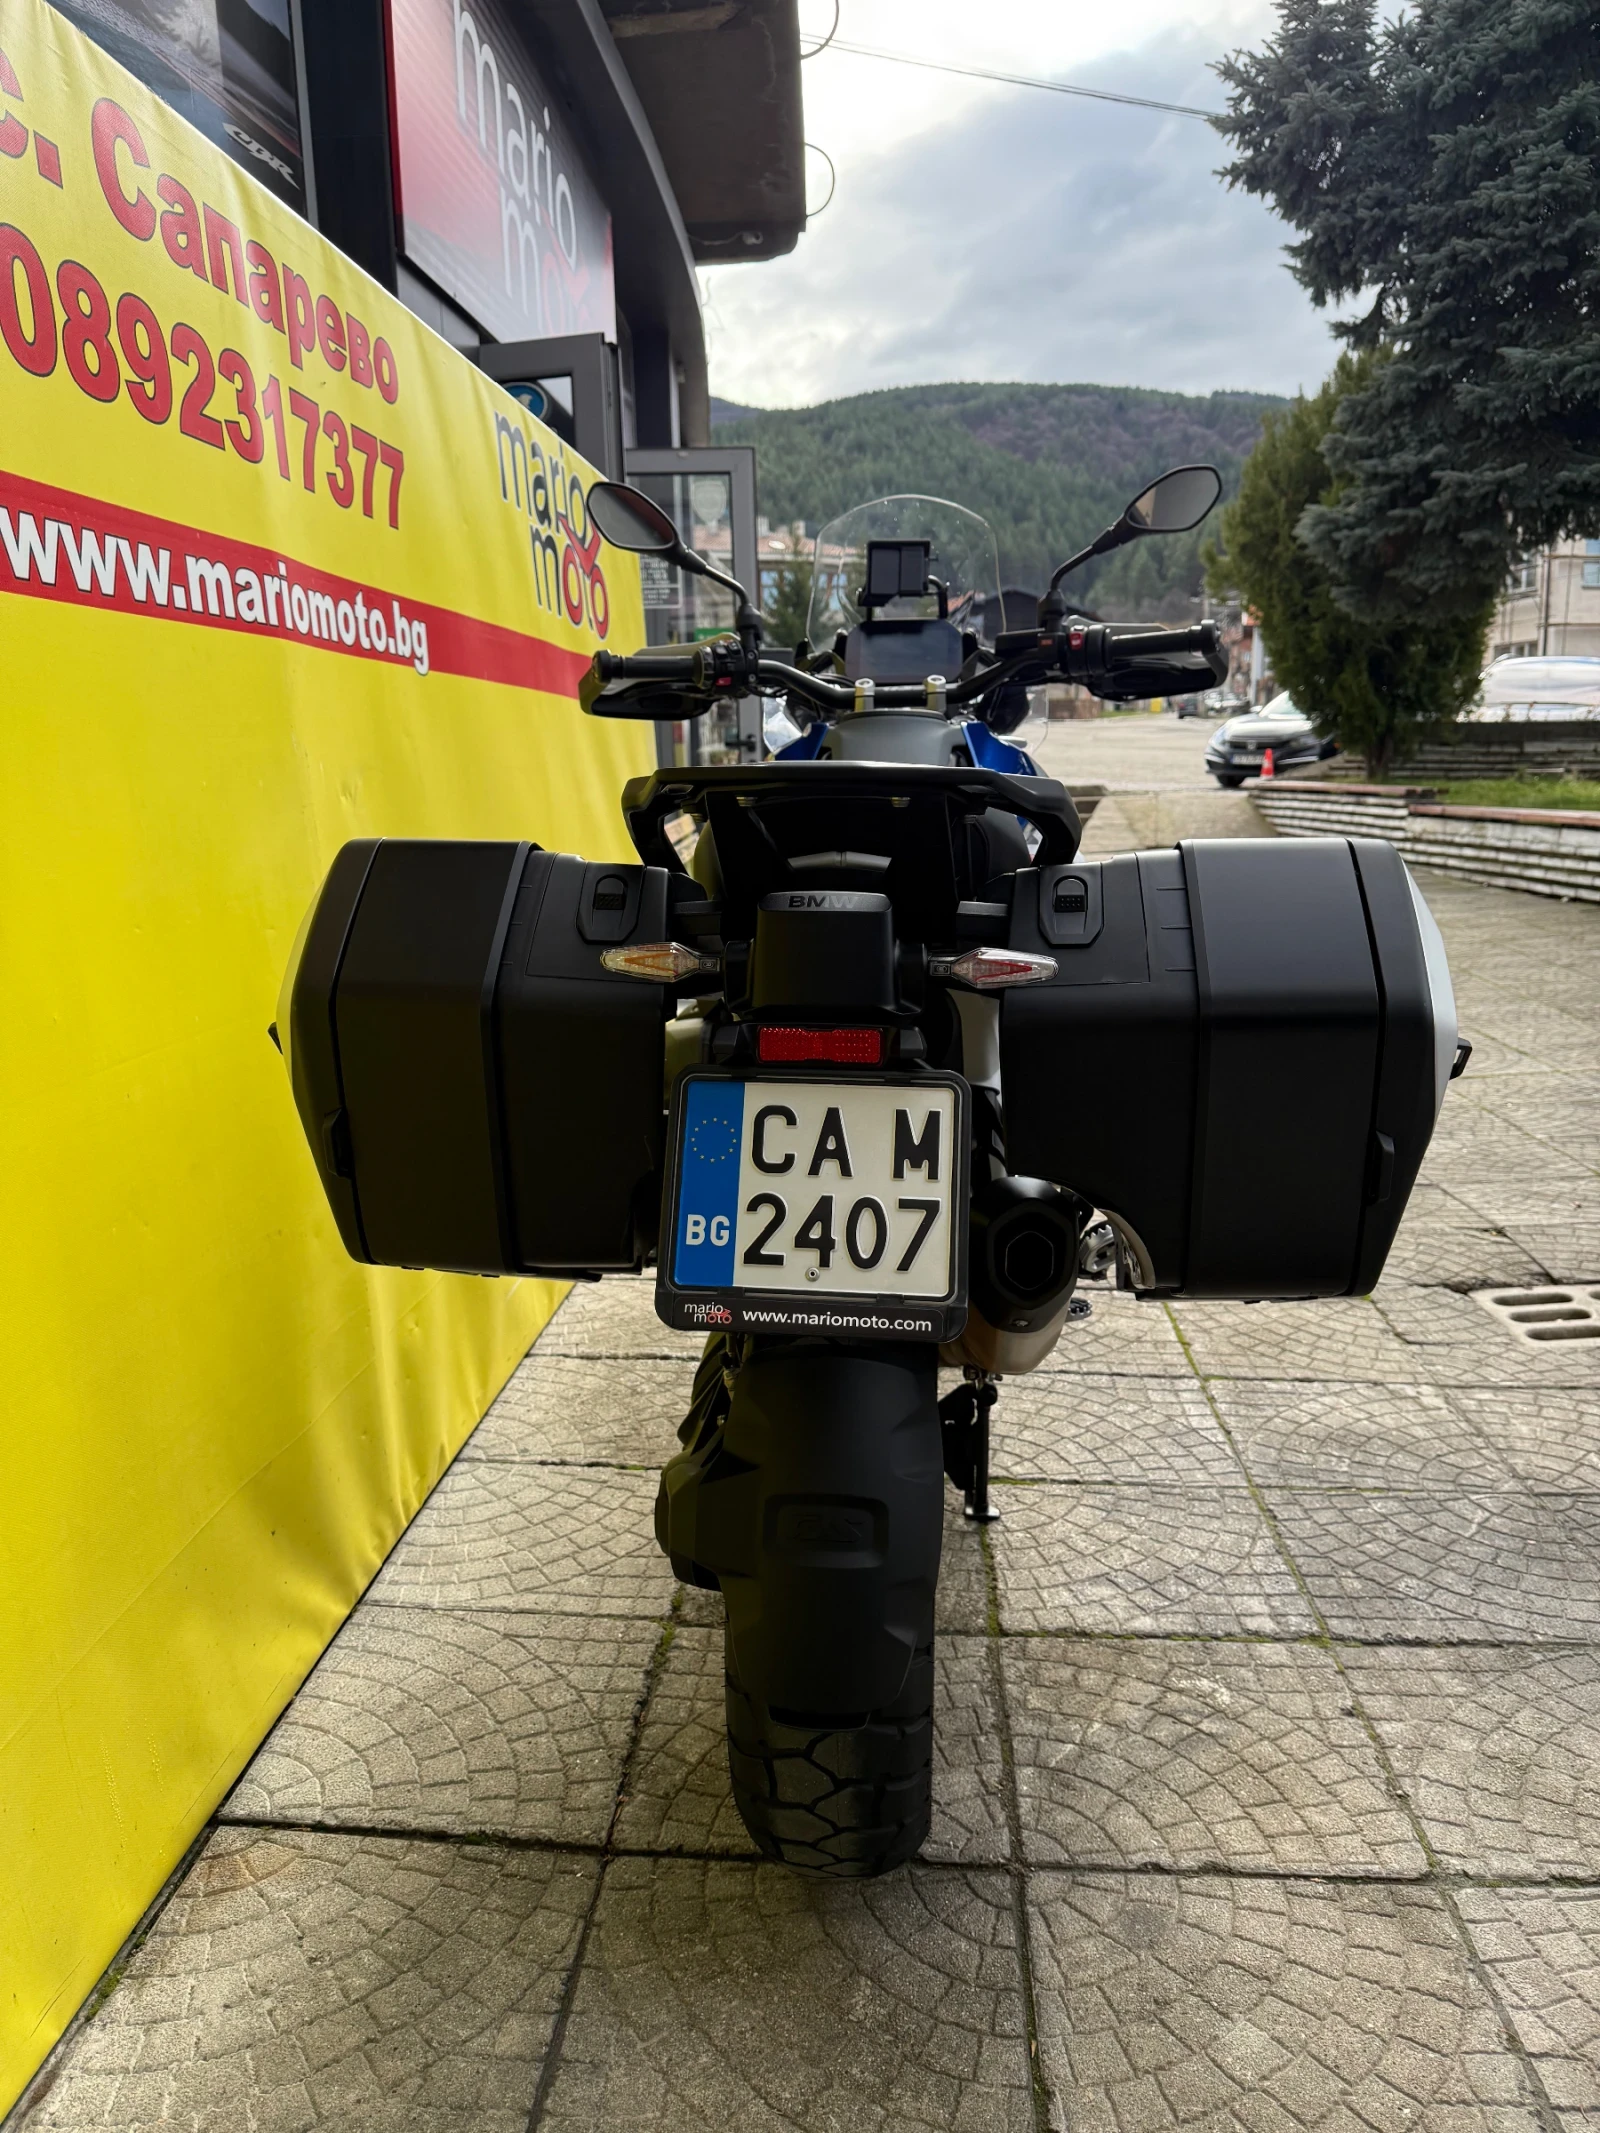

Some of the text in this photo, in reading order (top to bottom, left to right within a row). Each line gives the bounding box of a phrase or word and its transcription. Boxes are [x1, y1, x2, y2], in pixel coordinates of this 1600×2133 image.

[454, 0, 577, 272] mario
[91, 97, 399, 405] Сапарево
[0, 222, 404, 530] 0892317377
[494, 410, 587, 545] mario
[0, 505, 430, 675] www.mariomoto.bg
[530, 524, 609, 640] moto
[788, 895, 858, 909] BMW
[751, 1104, 942, 1181] CA M
[685, 1213, 731, 1247] BG
[743, 1192, 942, 1273] 2407
[684, 1302, 724, 1314] mario
[694, 1311, 732, 1324] moto
[742, 1310, 932, 1332] www.mariomoto.com
